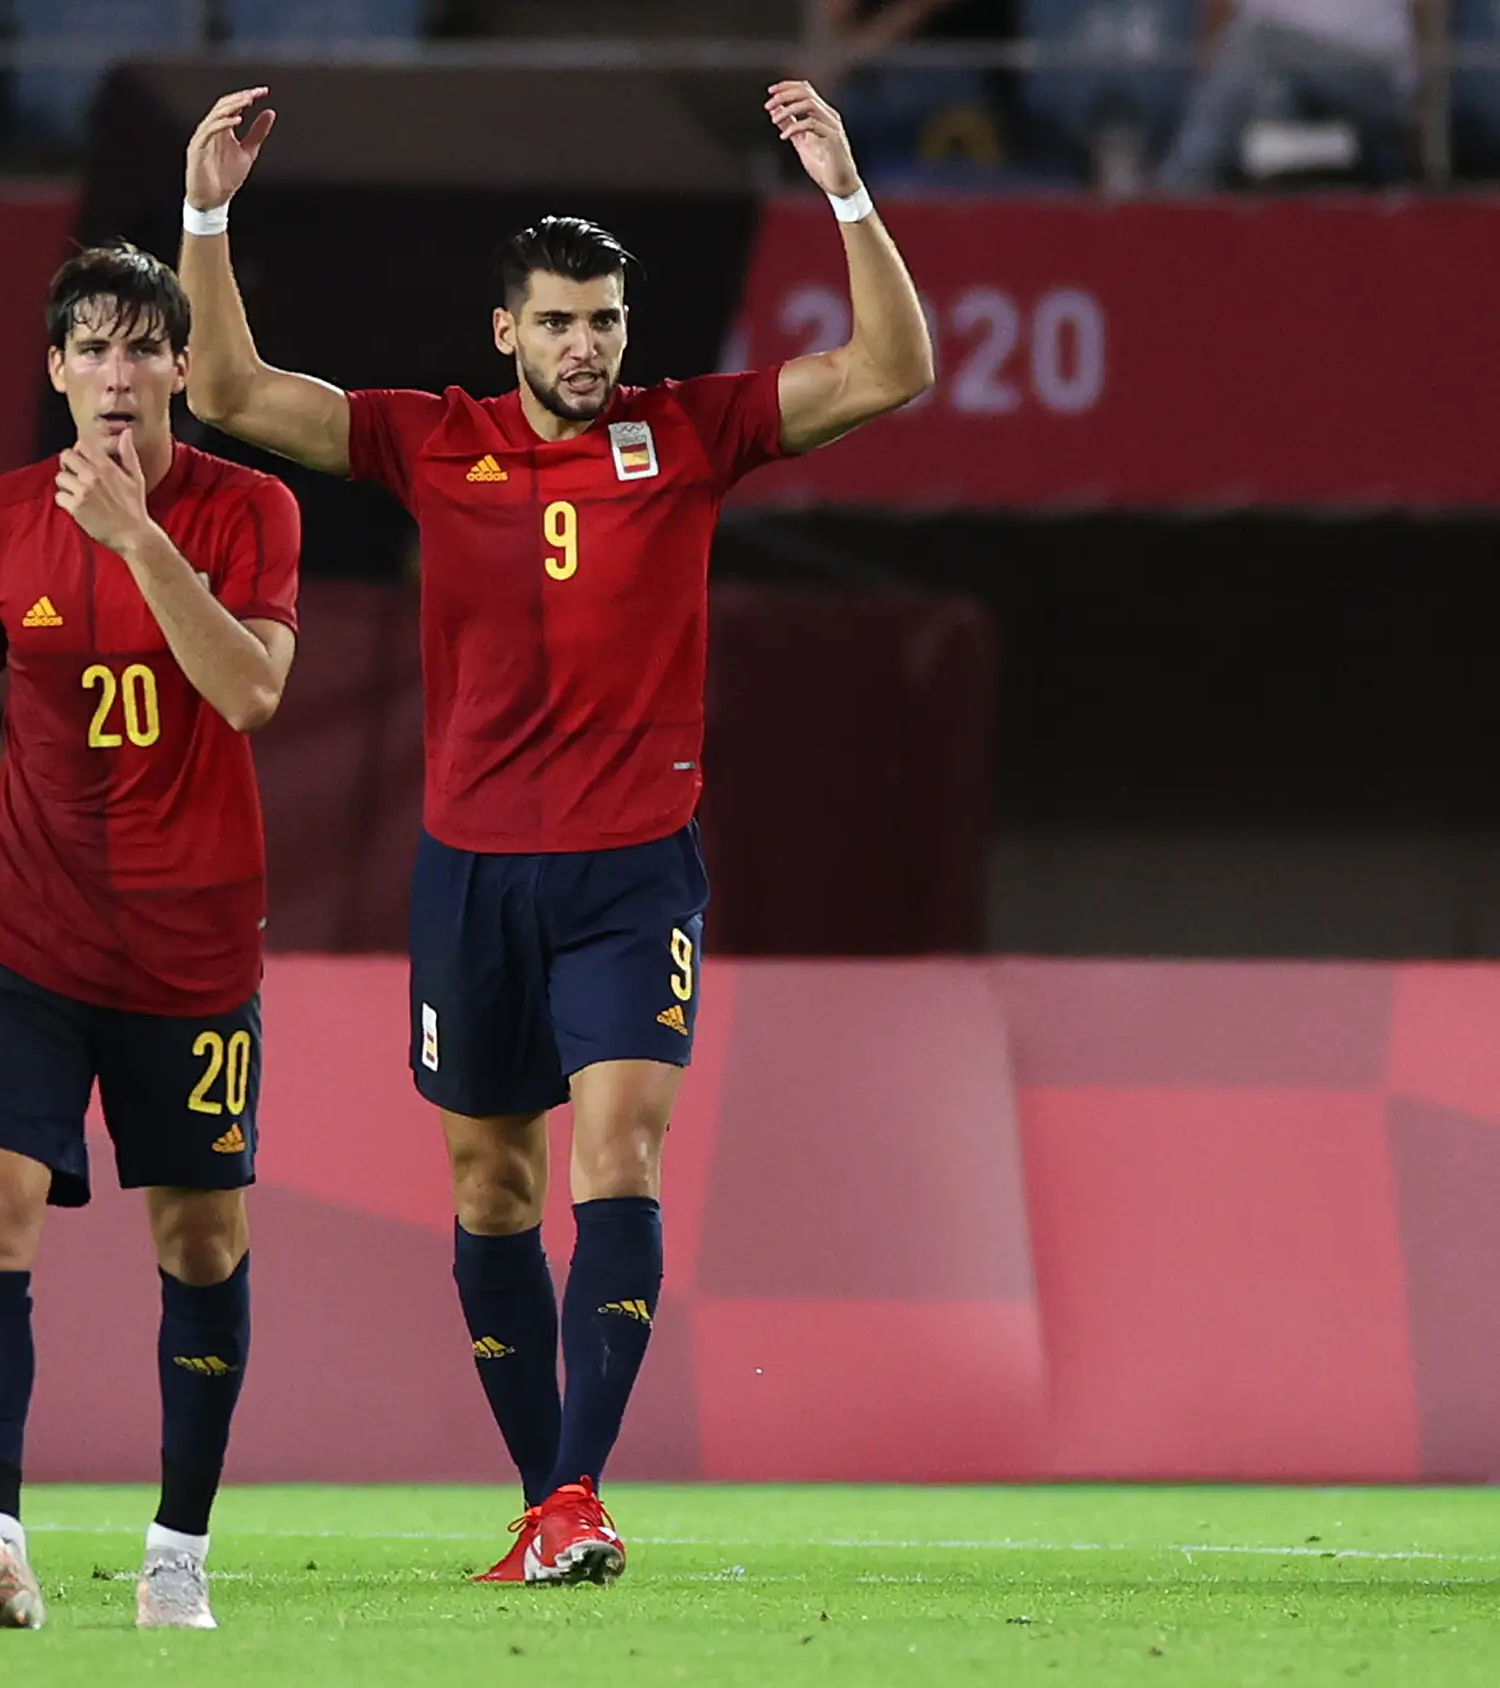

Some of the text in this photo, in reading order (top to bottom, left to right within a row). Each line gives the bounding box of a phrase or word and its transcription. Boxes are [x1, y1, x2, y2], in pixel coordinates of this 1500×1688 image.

[779, 283, 1106, 414] 220
[466, 470, 509, 482] adidas
[543, 500, 578, 582] 9
[81, 663, 161, 749] 20
[670, 927, 693, 1002] 9
[187, 1030, 252, 1116] 20
